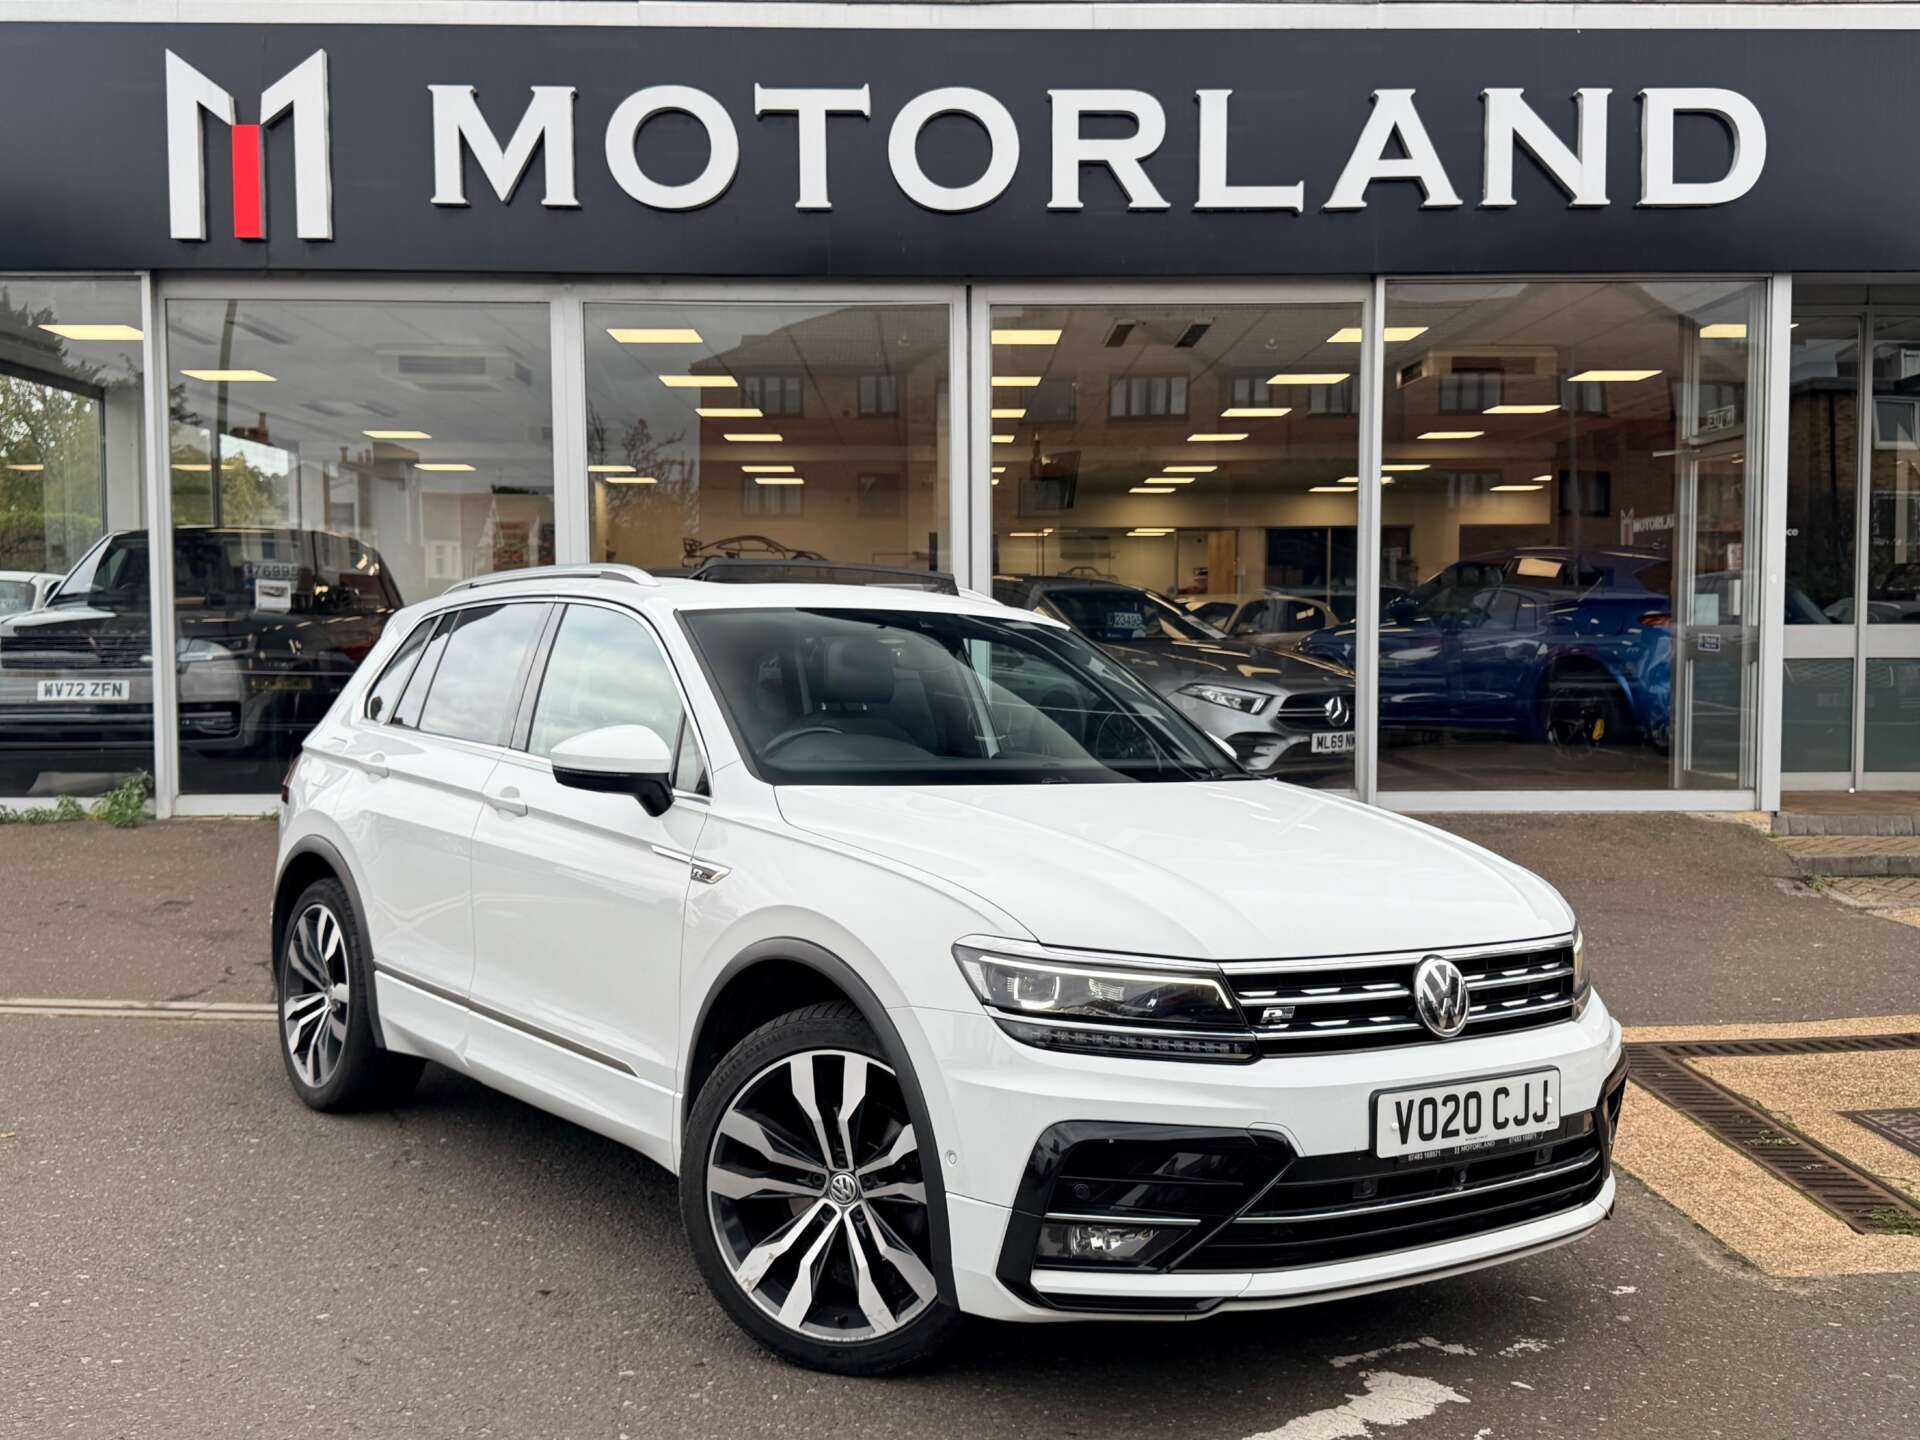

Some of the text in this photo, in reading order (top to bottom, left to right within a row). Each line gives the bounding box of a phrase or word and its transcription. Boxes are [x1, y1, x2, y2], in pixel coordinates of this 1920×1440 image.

[427, 83, 1767, 213] MOTORLAND
[44, 682, 123, 697] WV72 ZFN
[1316, 734, 1344, 750] ML69
[1395, 1079, 1549, 1145] VO20 CJJ
